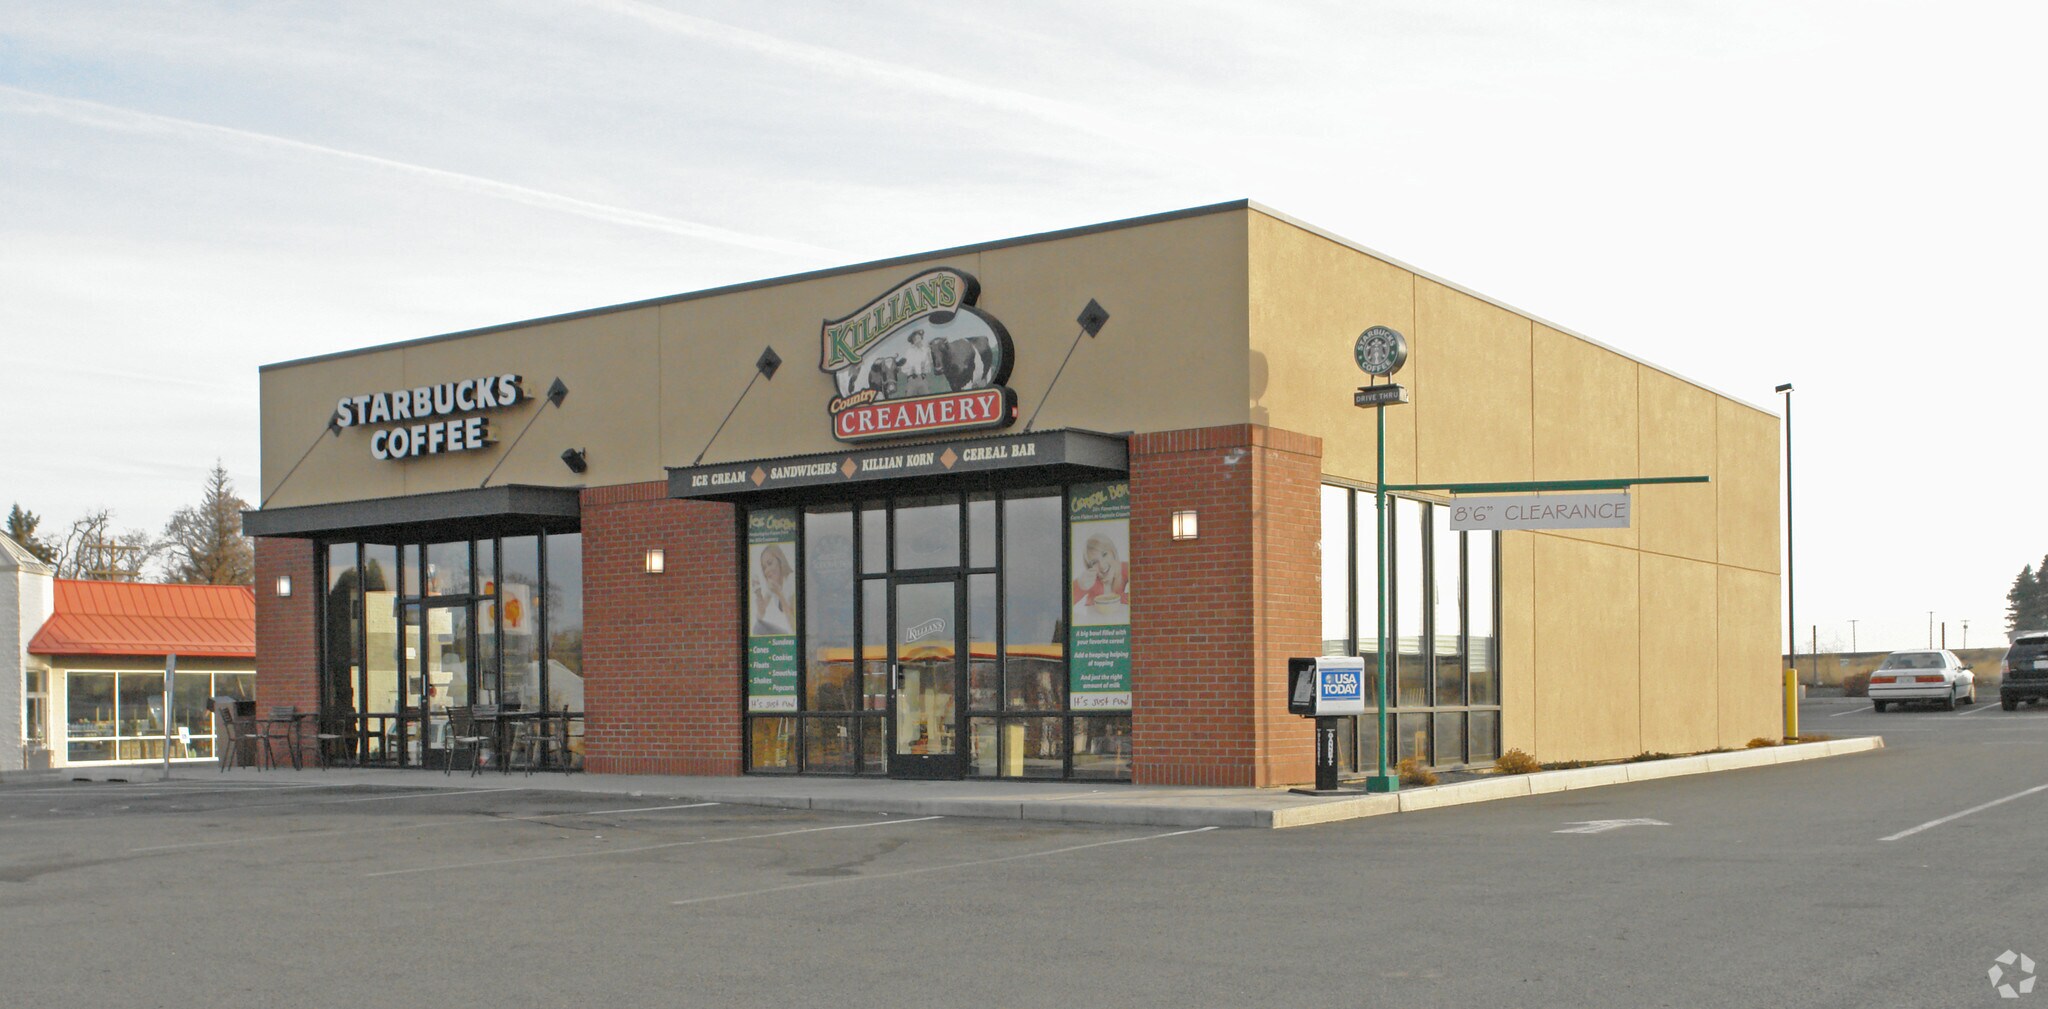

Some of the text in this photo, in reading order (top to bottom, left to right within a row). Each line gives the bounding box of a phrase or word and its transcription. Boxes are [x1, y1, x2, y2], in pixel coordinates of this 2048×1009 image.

[828, 273, 956, 364] KILLIAN'S
[1358, 329, 1395, 351] STARBUCKS
[1362, 361, 1391, 372] COFFEE
[337, 373, 518, 427] STARBUCKS
[831, 389, 877, 413] Country
[1356, 391, 1398, 402] DRIVE THRU
[841, 395, 995, 433] CREAMERY
[371, 417, 482, 460] COFFEE
[692, 443, 1035, 487] ICE CREAM SANDWICHES KILLIAN KORN CEREAL BAR
[1454, 503, 1626, 522] 8'6" CLEARANCE
[772, 684, 794, 692] Popcorn
[1323, 684, 1358, 695] TODAY
[1335, 673, 1357, 684] USA
